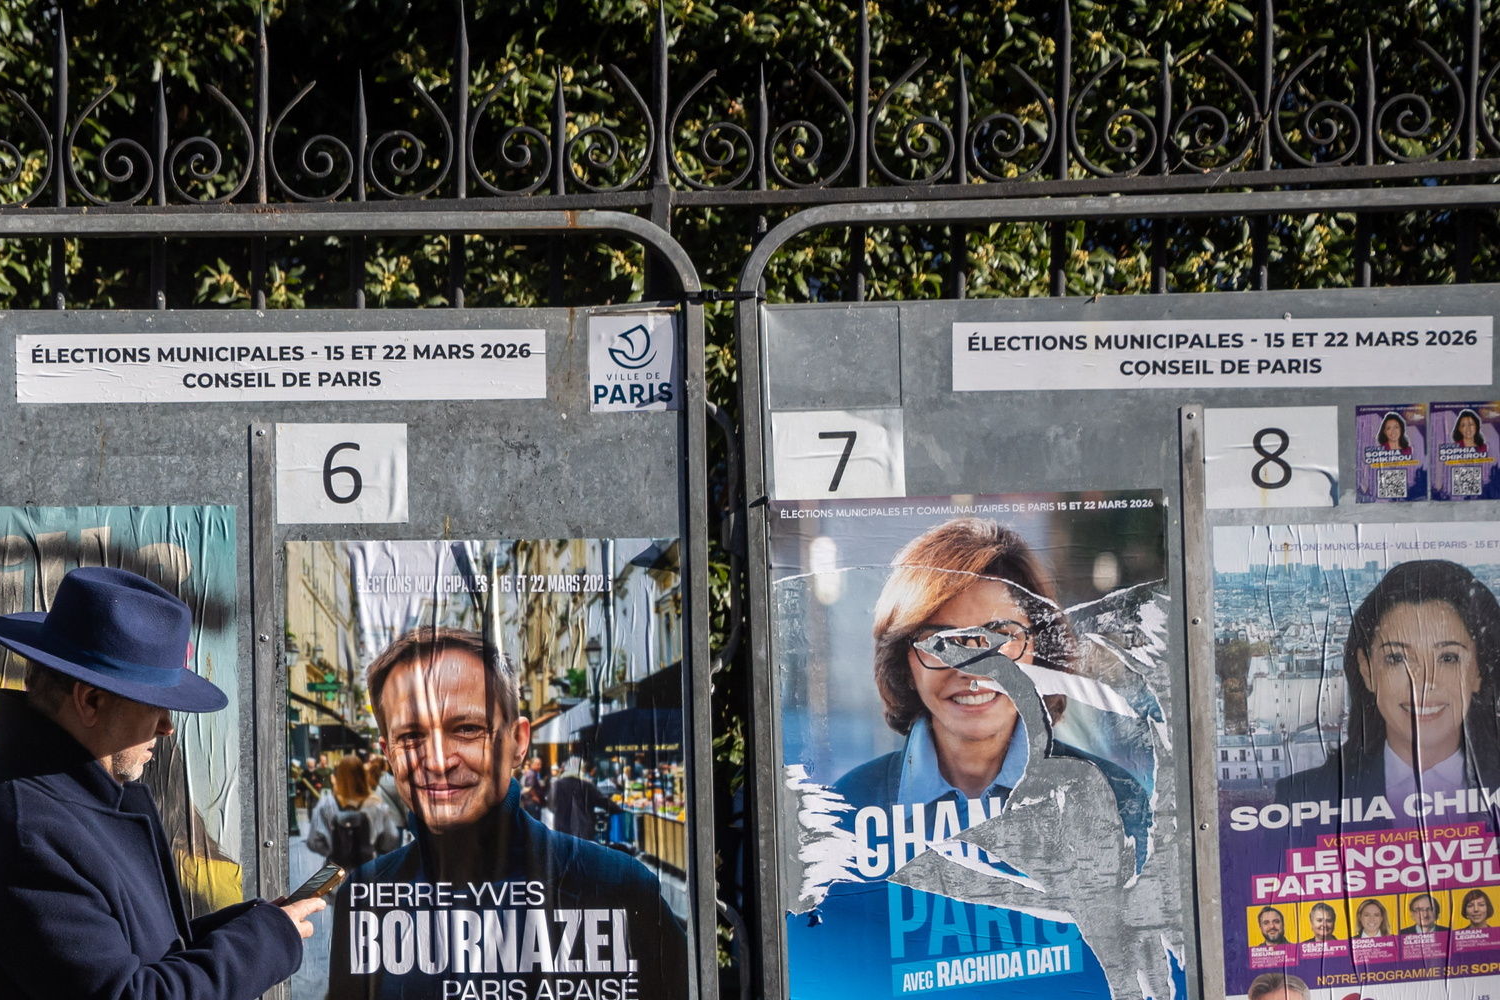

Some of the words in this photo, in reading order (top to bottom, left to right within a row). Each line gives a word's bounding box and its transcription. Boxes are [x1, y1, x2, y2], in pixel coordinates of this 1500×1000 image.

[967, 332, 1087, 352] ÉLECTIONS
[1094, 332, 1244, 350] MUNICIPALES
[1264, 333, 1285, 348] 15
[1291, 332, 1318, 348] ET
[1324, 332, 1349, 347] 22
[1356, 331, 1419, 347] MARS
[1425, 330, 1477, 346] 2026
[32, 345, 150, 364] ÉLECTIONS
[157, 345, 304, 363] MUNICIPALES
[324, 345, 344, 361] 15
[351, 345, 377, 361] ET
[383, 344, 406, 361] 22
[412, 344, 475, 360] MARS
[480, 342, 531, 359] 2026
[1119, 359, 1214, 377] CONSEIL
[1221, 360, 1250, 375] DE
[1257, 358, 1322, 375] PARIS
[182, 373, 276, 389] CONSEIL
[282, 372, 310, 388] DE
[318, 371, 382, 387] PARIS
[593, 382, 674, 406] PARIS
[818, 430, 858, 492] 7
[1251, 428, 1293, 490] 8
[322, 441, 363, 504] 6
[780, 508, 833, 519] ÉLECTIONS
[836, 507, 900, 518] MUNICIPALES
[902, 507, 914, 516] ET
[916, 504, 1010, 516] COMMUNAUTAIRES
[1012, 503, 1025, 512] DE
[1028, 502, 1055, 511] PARIS
[1057, 502, 1067, 511] 15
[1069, 501, 1082, 510] ET
[1084, 501, 1096, 510] 22
[1098, 500, 1127, 509] MARS
[1130, 499, 1154, 508] 2026
[548, 574, 580, 592] MARS
[1230, 796, 1396, 832] SOPHIA
[1323, 834, 1375, 848] VOTRE
[1380, 830, 1430, 843] MAIRE
[1433, 826, 1479, 839] POUR
[1292, 850, 1338, 873] LE
[350, 880, 545, 908] PIERRE-YVES
[1256, 867, 1367, 899] PARIS
[349, 908, 638, 976] BOURNAZEL
[902, 970, 935, 992] AVEC
[936, 951, 1023, 988] RACHIDA
[1026, 944, 1071, 975] DATI
[1316, 973, 1358, 986] NOTRE
[1360, 967, 1441, 982] PROGRAMME
[1443, 965, 1469, 976] SUR
